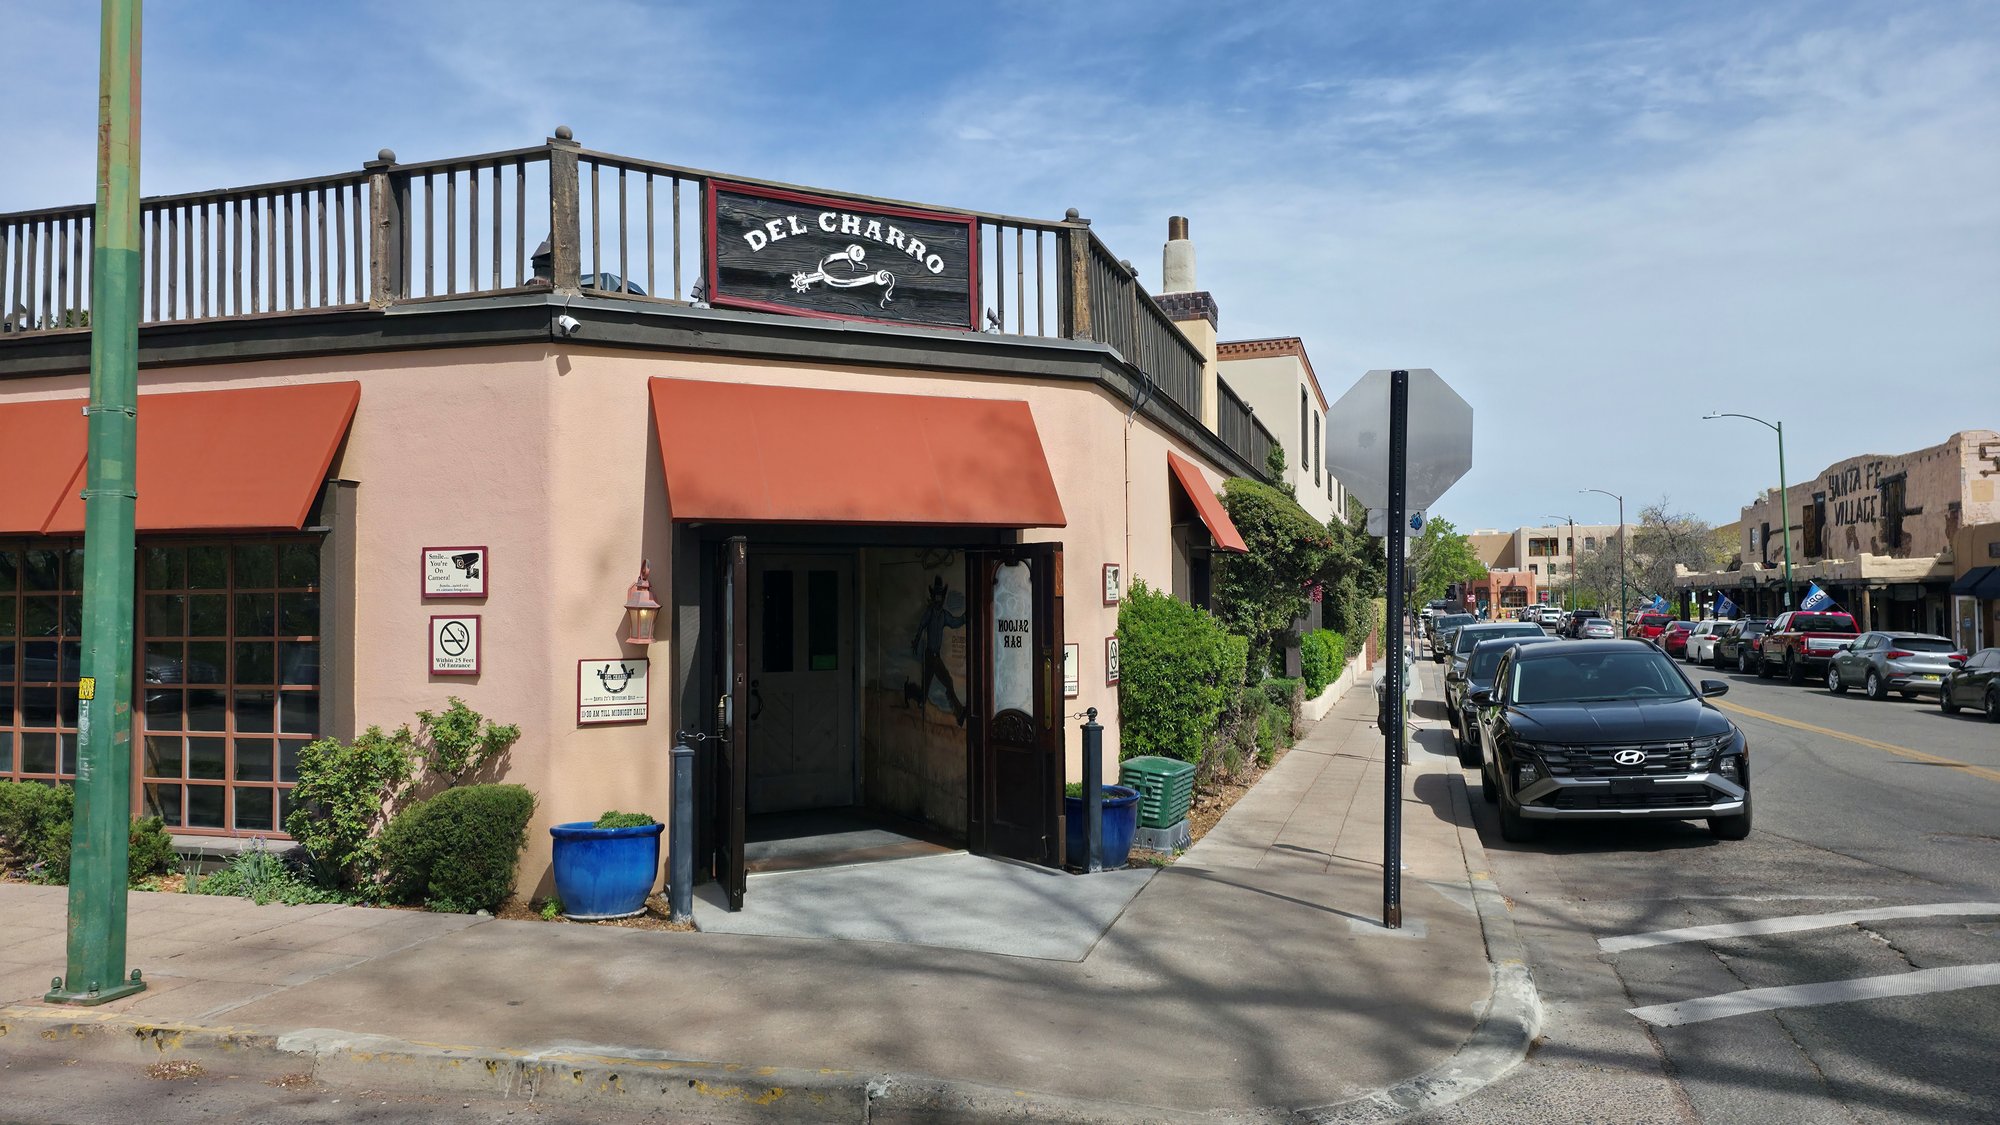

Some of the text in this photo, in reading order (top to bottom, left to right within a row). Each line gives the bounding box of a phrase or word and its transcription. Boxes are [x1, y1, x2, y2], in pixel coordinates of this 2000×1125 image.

[743, 211, 945, 274] DEL CHARRO
[1828, 461, 1883, 502] SANTA FE
[1834, 495, 1878, 526] VILLAGE
